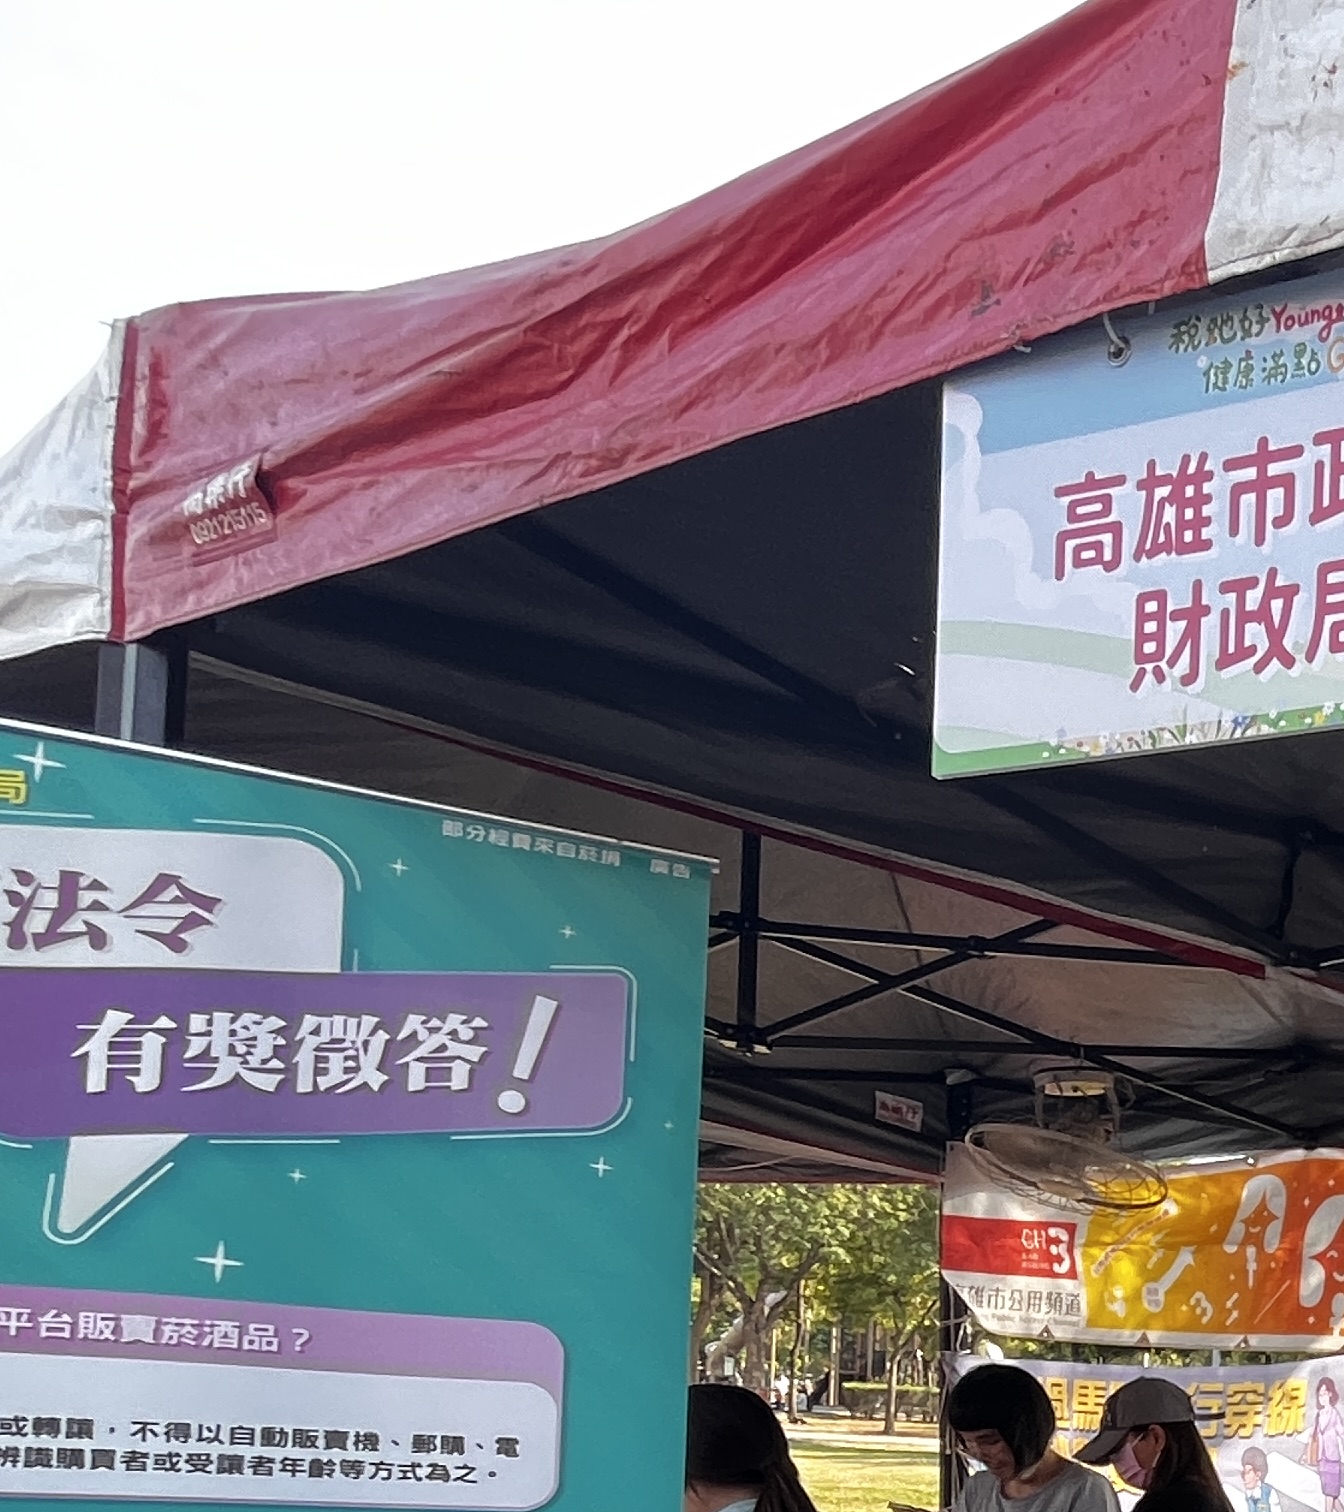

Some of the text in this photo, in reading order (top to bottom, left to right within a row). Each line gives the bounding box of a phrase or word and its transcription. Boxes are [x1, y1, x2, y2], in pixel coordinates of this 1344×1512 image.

[2, 868, 224, 954] 法令
[954, 1284, 1082, 1318] 雄市公用頻道
